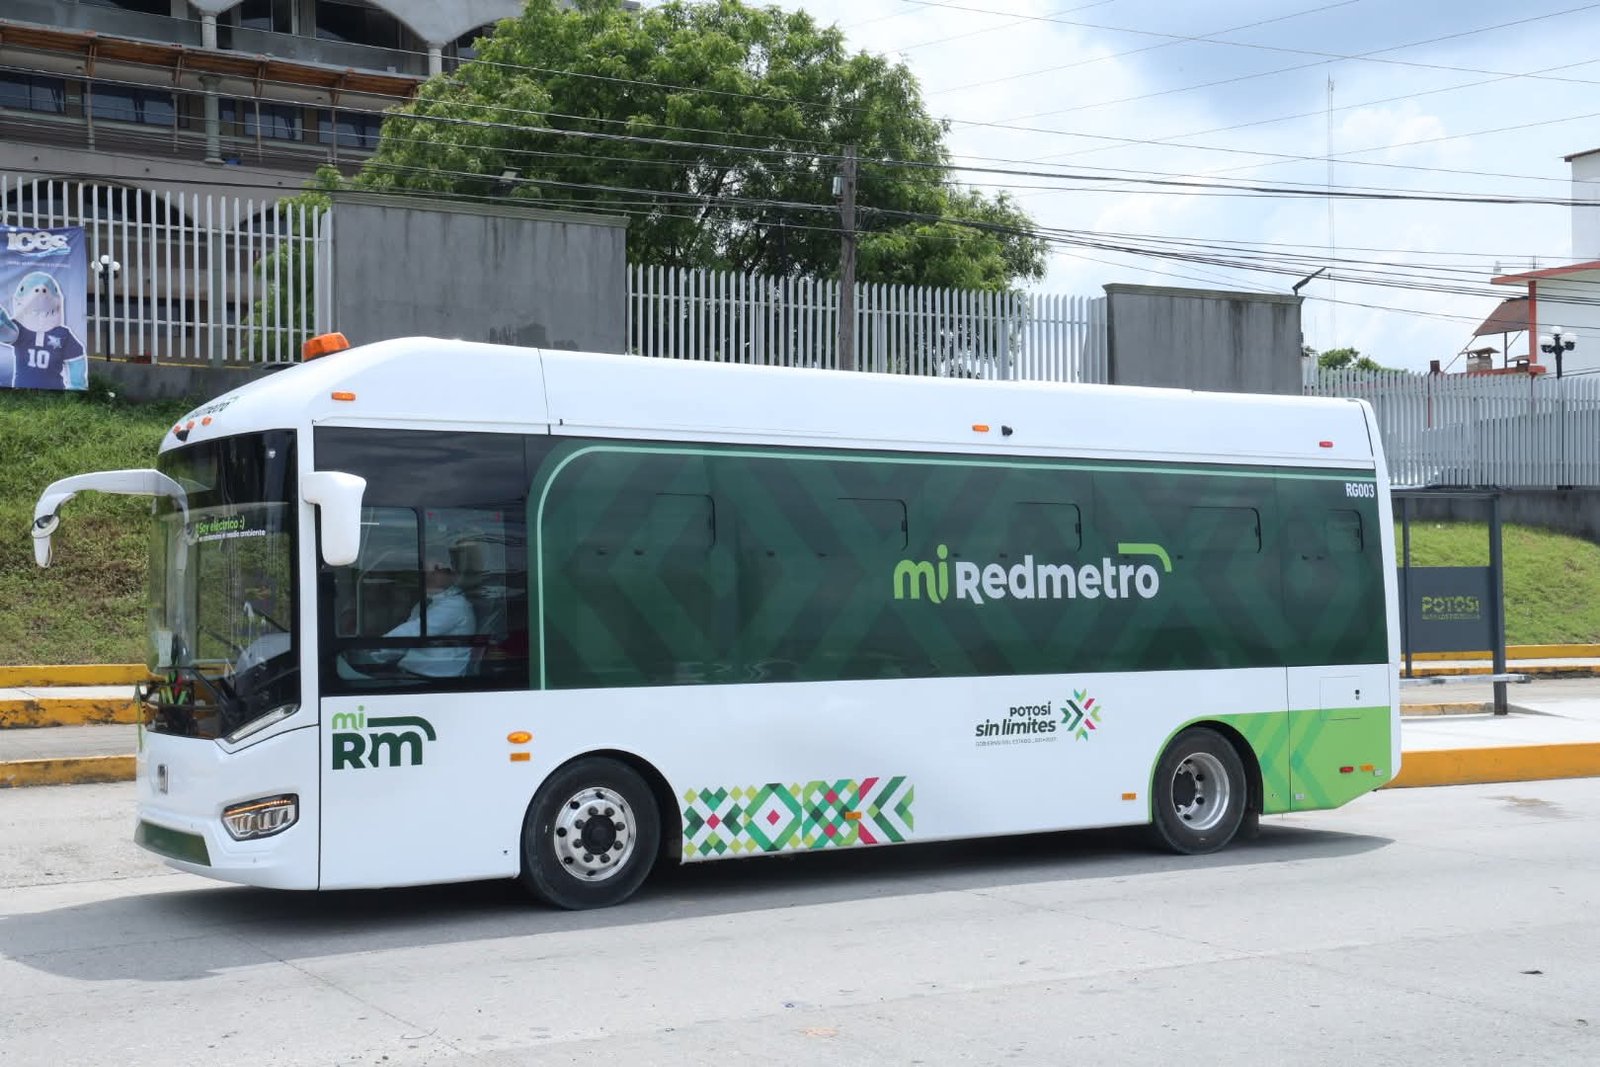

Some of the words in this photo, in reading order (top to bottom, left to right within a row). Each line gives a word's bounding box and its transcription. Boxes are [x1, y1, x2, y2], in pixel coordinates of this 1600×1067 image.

[27, 349, 51, 369] 10
[1345, 482, 1375, 498] RG003
[241, 528, 266, 537] ambiente
[893, 543, 949, 604] mi
[955, 554, 1160, 604] Redmetro
[331, 705, 365, 731] mi
[975, 719, 1000, 737] sin
